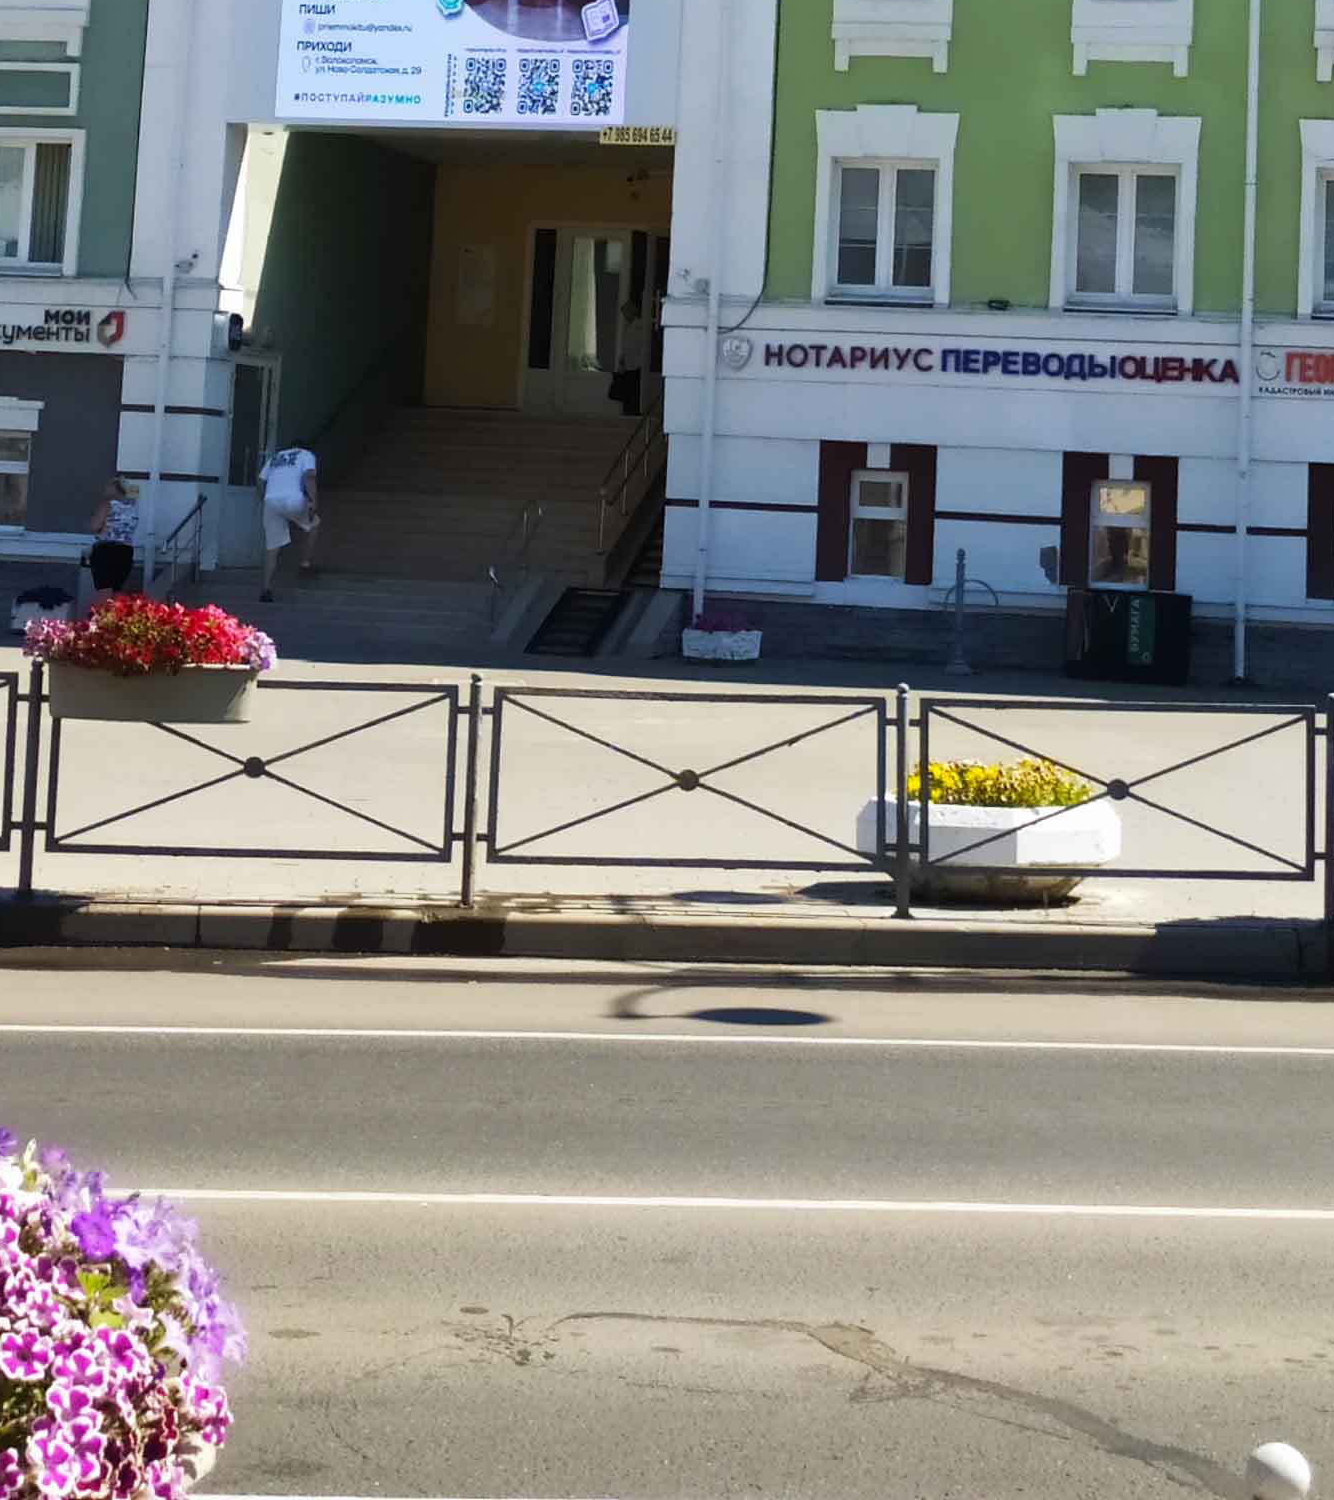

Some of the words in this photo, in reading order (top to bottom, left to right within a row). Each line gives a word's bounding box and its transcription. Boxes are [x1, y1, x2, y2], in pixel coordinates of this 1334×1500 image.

[299, 4, 336, 15] ПИШИ
[297, 40, 352, 53] ПРИХОДИ
[294, 92, 422, 105] #ПОСТУПАЙРАЗУМНО
[44, 309, 91, 326] мои
[763, 344, 934, 372] НОТАРИУС
[1258, 386, 1322, 396] КАДАСТРОВЫЙ
[1129, 598, 1141, 653] БУМАГА
